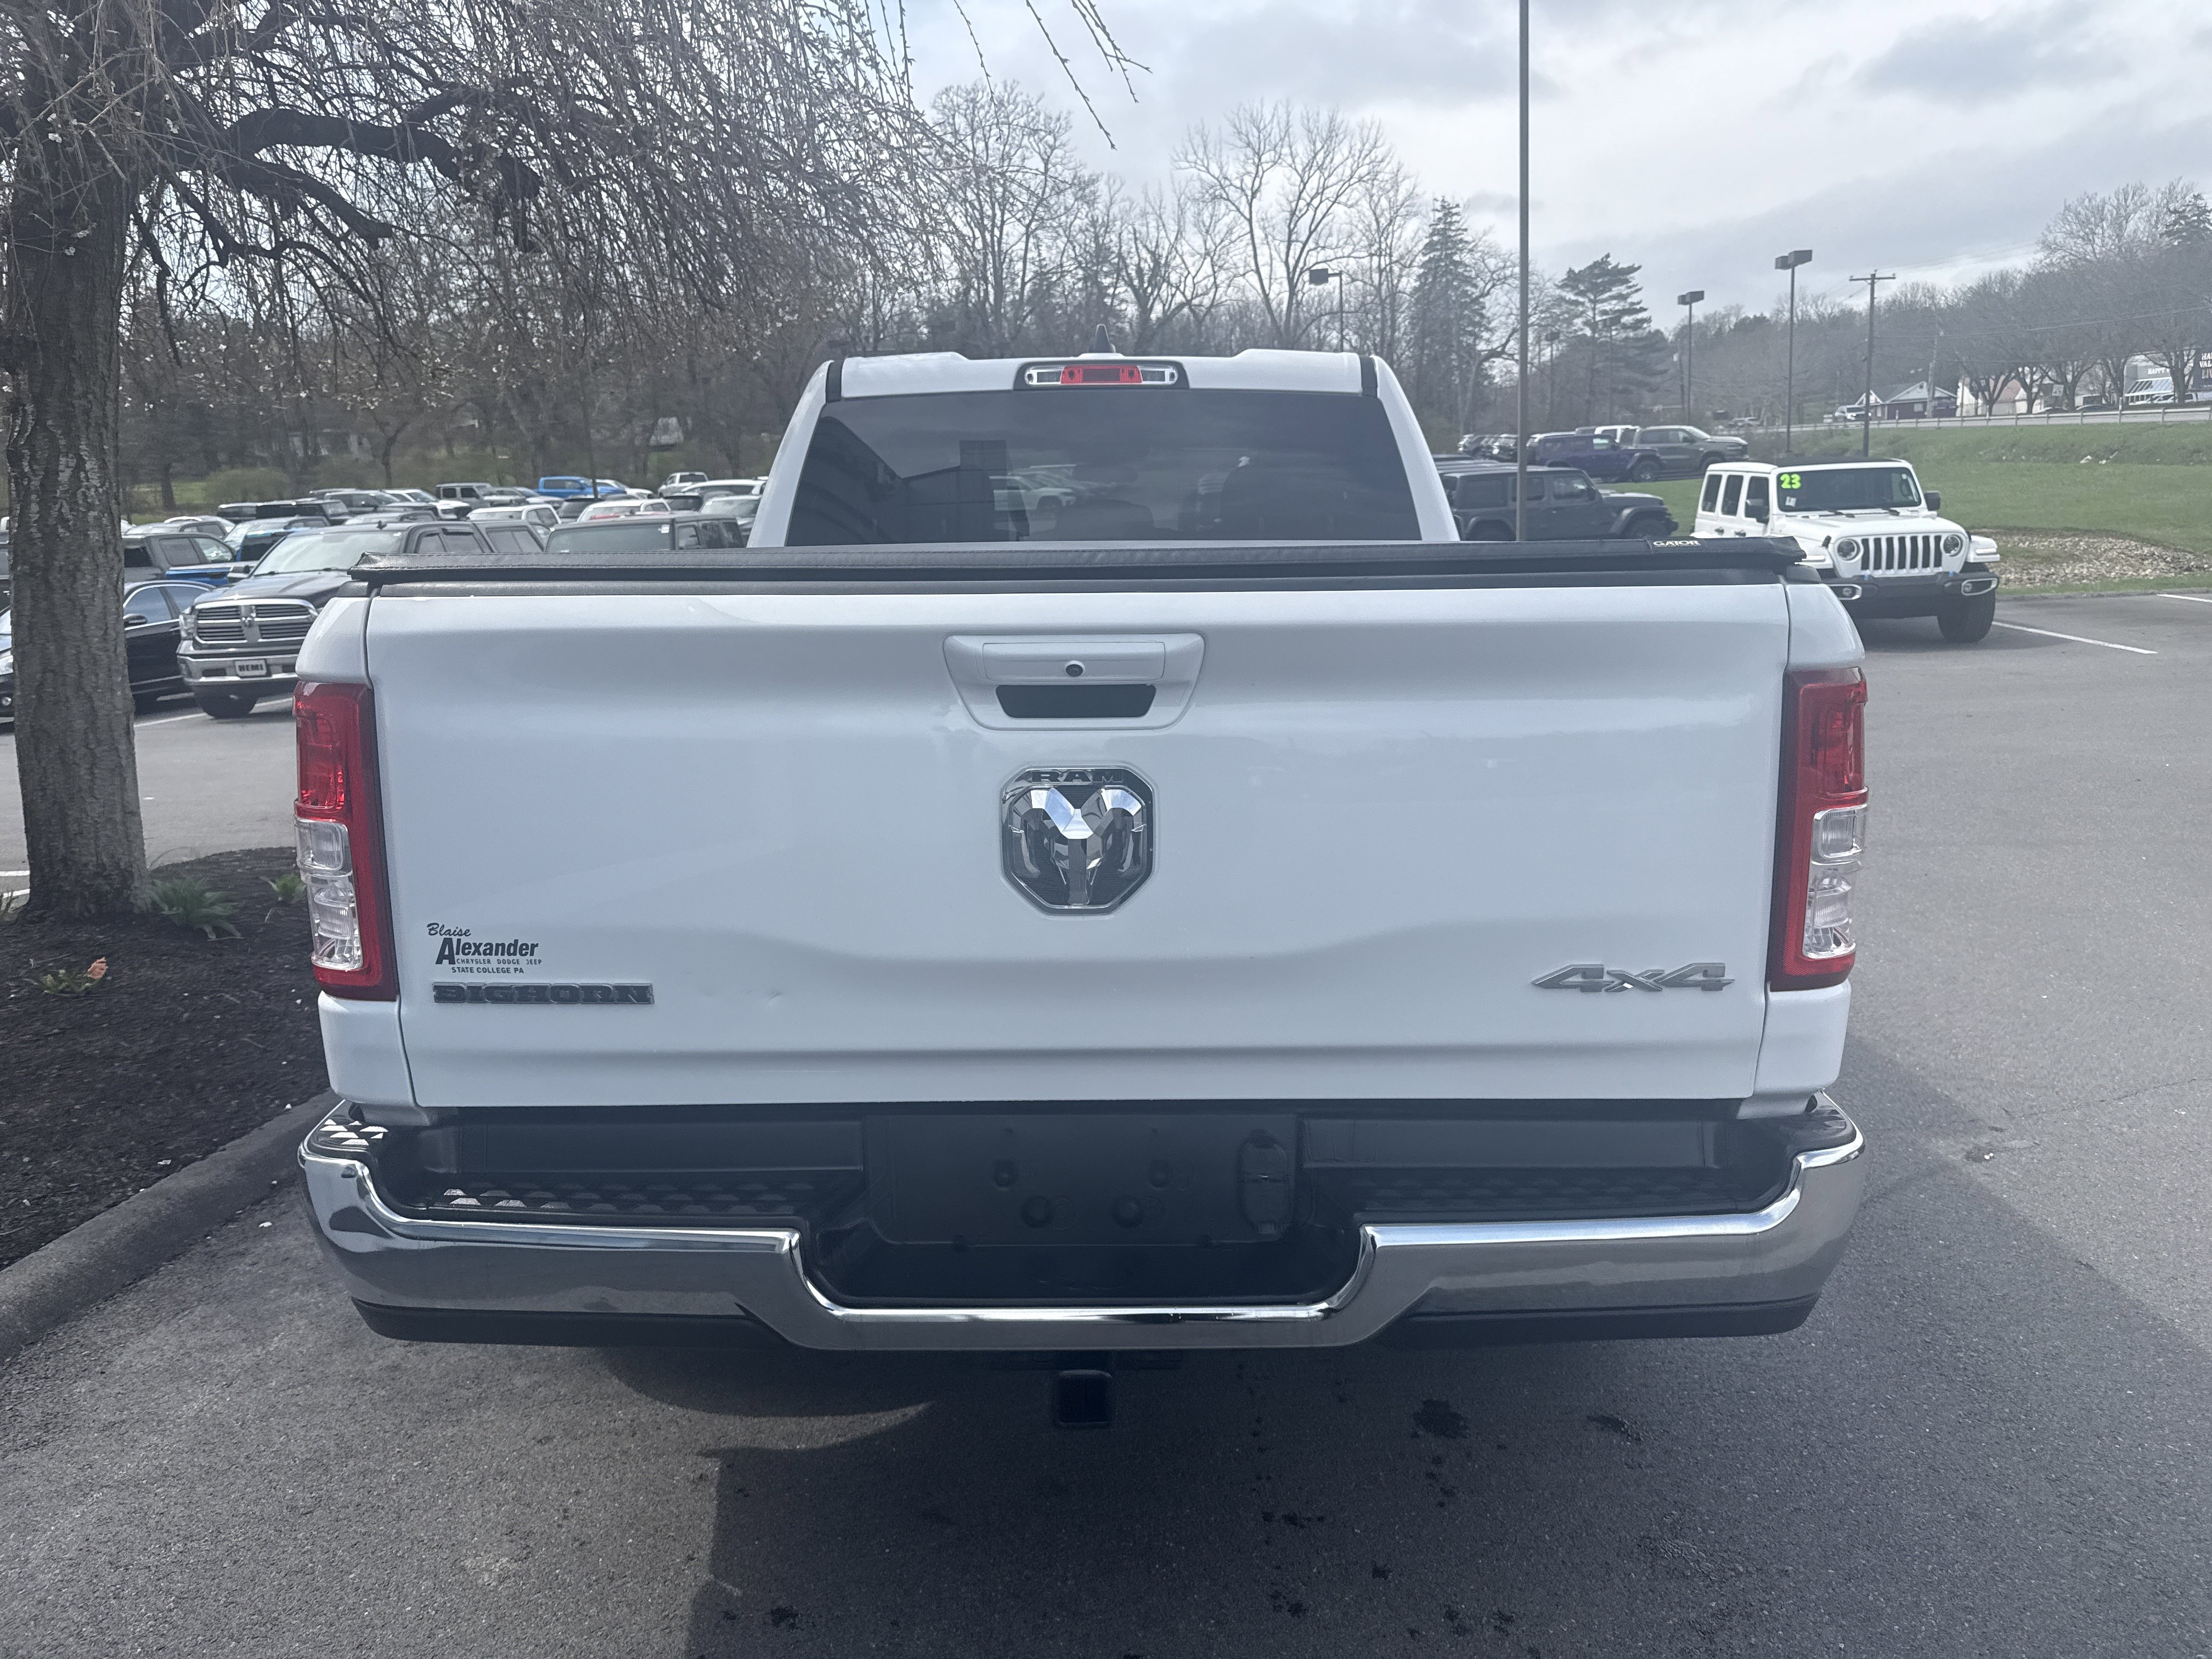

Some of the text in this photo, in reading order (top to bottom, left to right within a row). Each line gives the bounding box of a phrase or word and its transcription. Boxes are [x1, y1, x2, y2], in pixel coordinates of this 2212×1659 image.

[1780, 473, 1802, 489] 23
[1031, 771, 1122, 783] RAM
[427, 922, 471, 936] Blaise
[435, 937, 539, 964] Alexander
[433, 981, 654, 1005] BIGHORN
